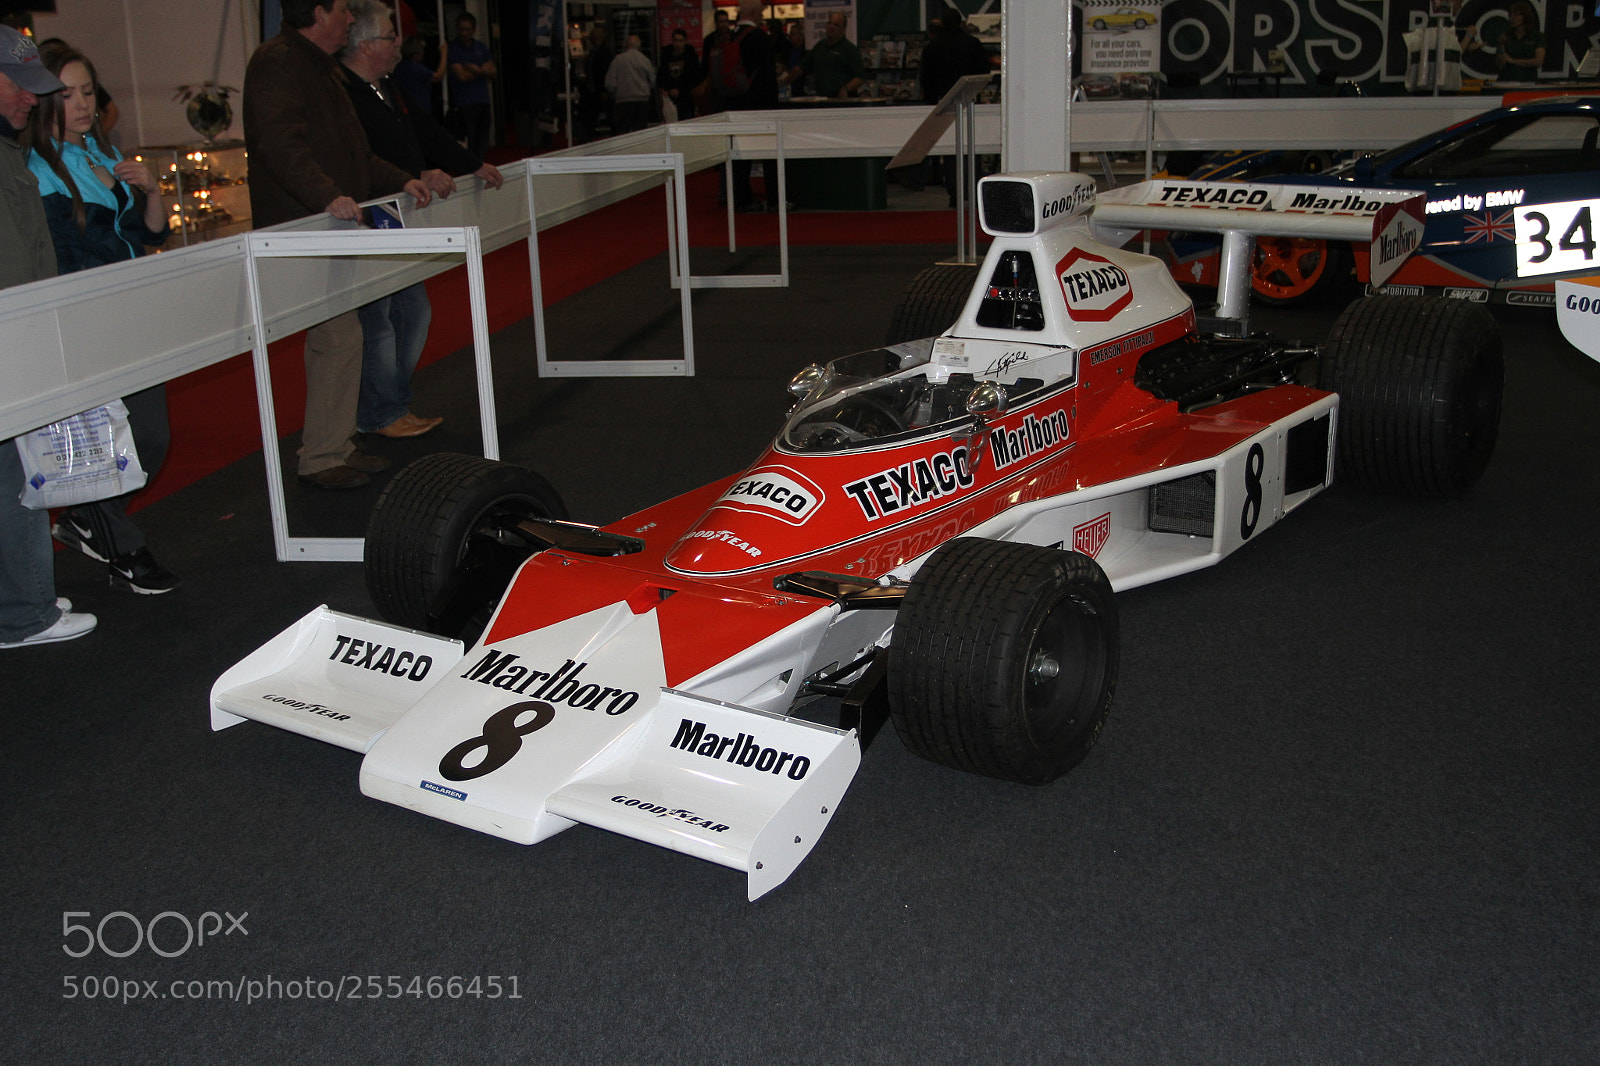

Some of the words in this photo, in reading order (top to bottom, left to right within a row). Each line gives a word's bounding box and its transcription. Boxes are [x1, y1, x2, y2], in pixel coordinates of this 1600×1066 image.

[1095, 51, 1107, 59] you
[1124, 50, 1138, 58] only
[1102, 39, 1110, 48] all
[1111, 40, 1125, 49] your
[1122, 60, 1149, 68] provider
[1160, 187, 1268, 205] TEXACO
[1291, 193, 1395, 212] Marlbo
[1463, 194, 1483, 211] by
[1485, 189, 1525, 207] BMW
[1379, 221, 1417, 265] Marlboro
[1523, 206, 1596, 264] 34
[1063, 265, 1127, 302] TEXACO
[1090, 343, 1121, 366] EMERSON
[1122, 331, 1154, 355] FITTIPALDI
[843, 447, 974, 521] TEXACO
[990, 410, 1069, 471] Marlboro
[1240, 442, 1265, 541] 8
[1077, 521, 1107, 554] HEUER
[329, 635, 433, 682] TEXACO
[460, 649, 640, 716] Marlboro
[262, 694, 351, 721] GOODYEAR
[438, 700, 556, 782] 8
[670, 719, 811, 781] Marlboro
[424, 782, 462, 799] McLAREN
